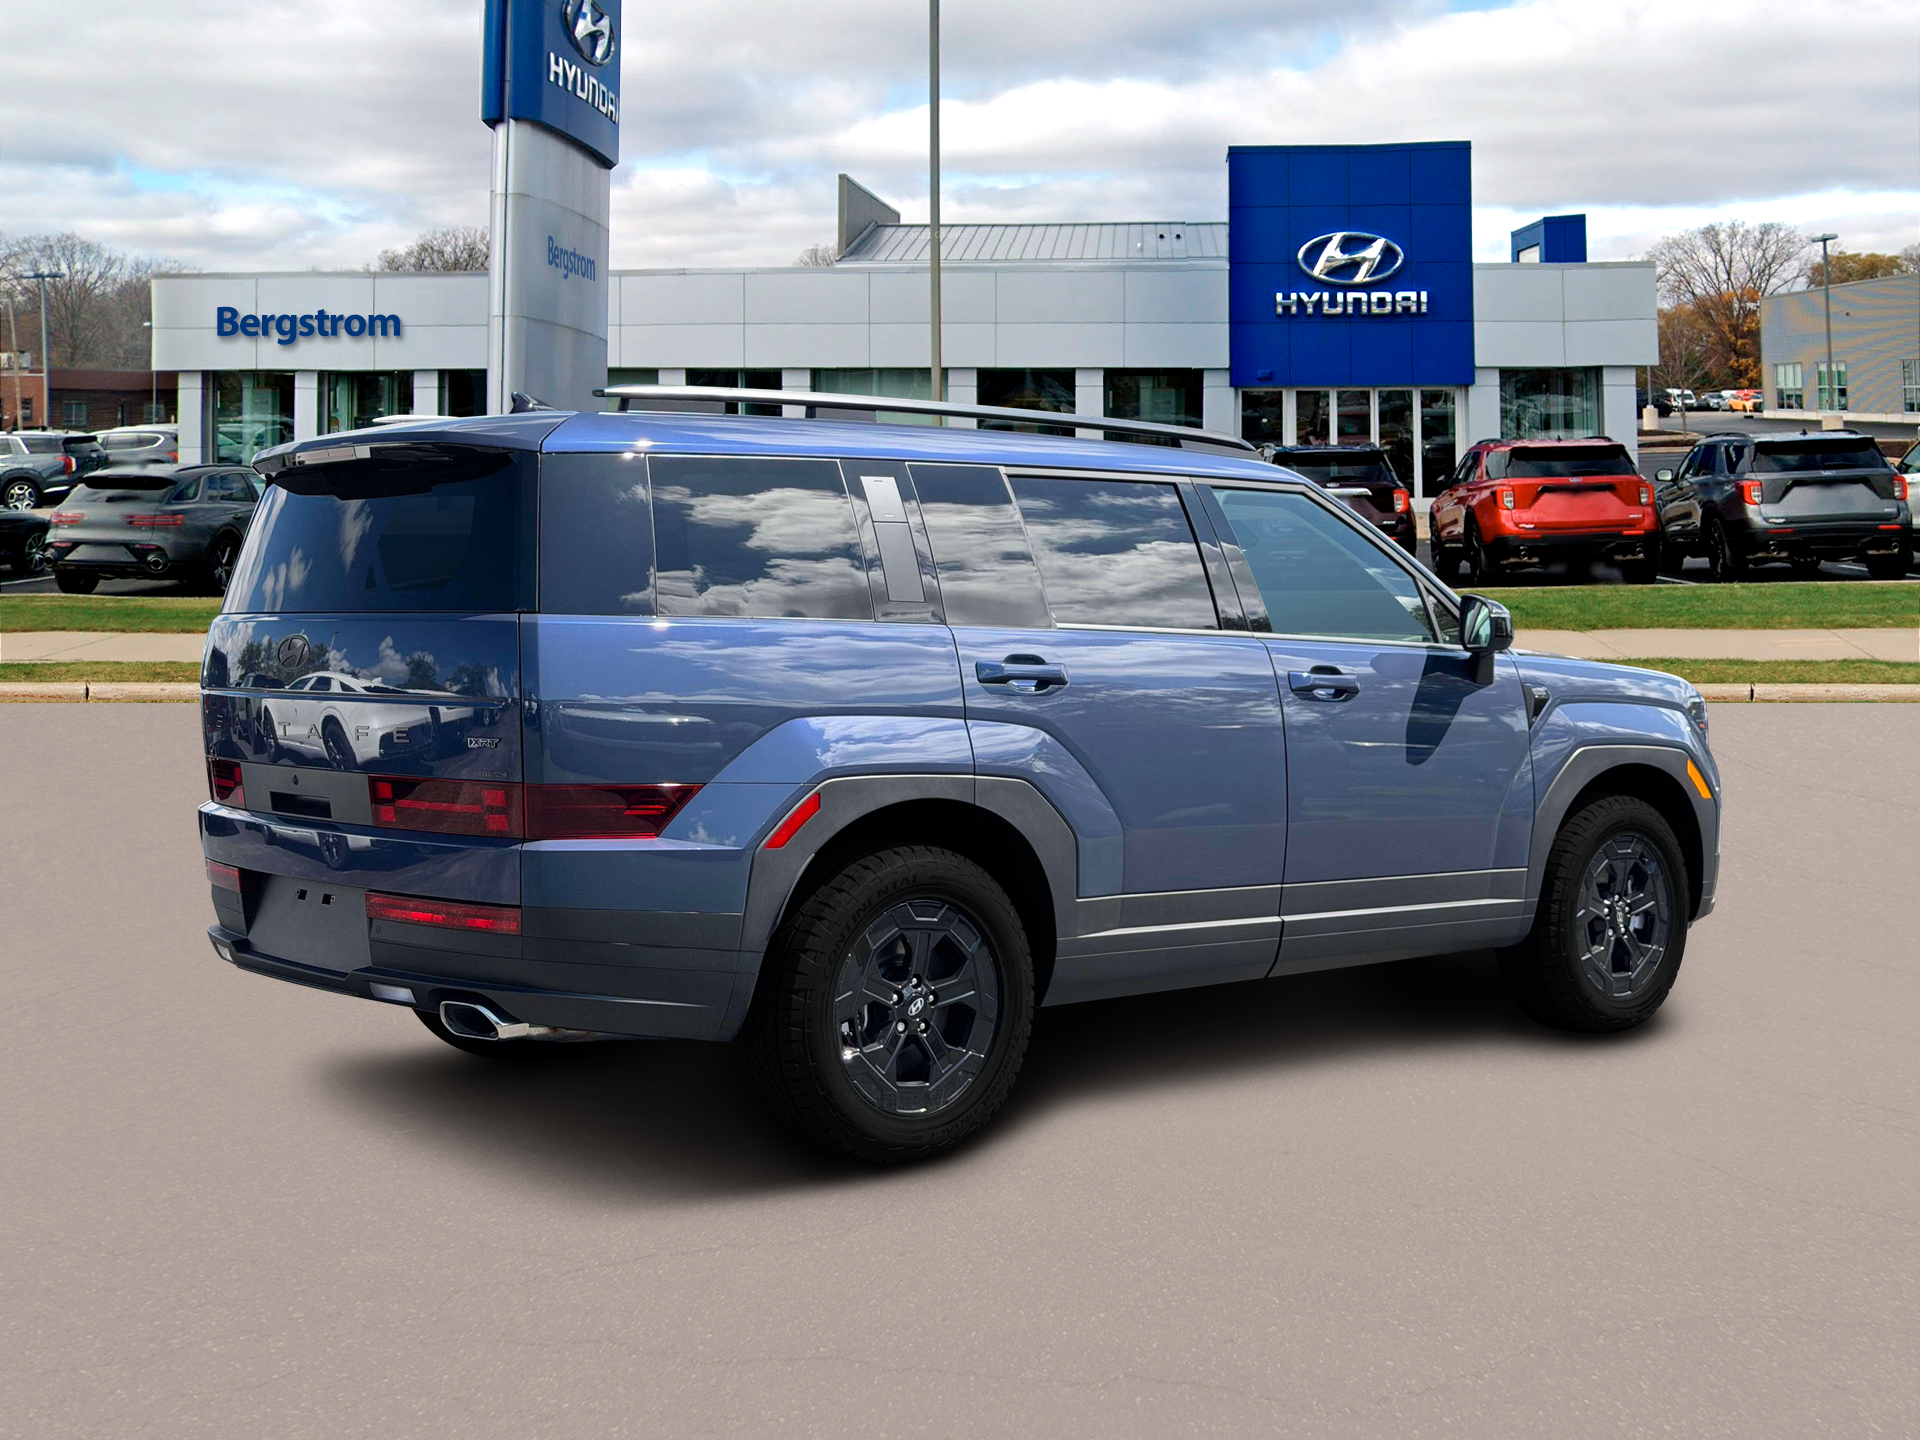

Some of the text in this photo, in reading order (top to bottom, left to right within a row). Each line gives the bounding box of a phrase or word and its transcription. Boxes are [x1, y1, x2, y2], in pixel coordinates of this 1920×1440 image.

[549, 51, 619, 124] HYUNDAI
[547, 235, 596, 281] Bergstrom
[1275, 290, 1428, 315] HYUNDAI
[216, 306, 402, 346] Bergstrom
[354, 725, 411, 743] FE
[467, 737, 502, 749] XRT
